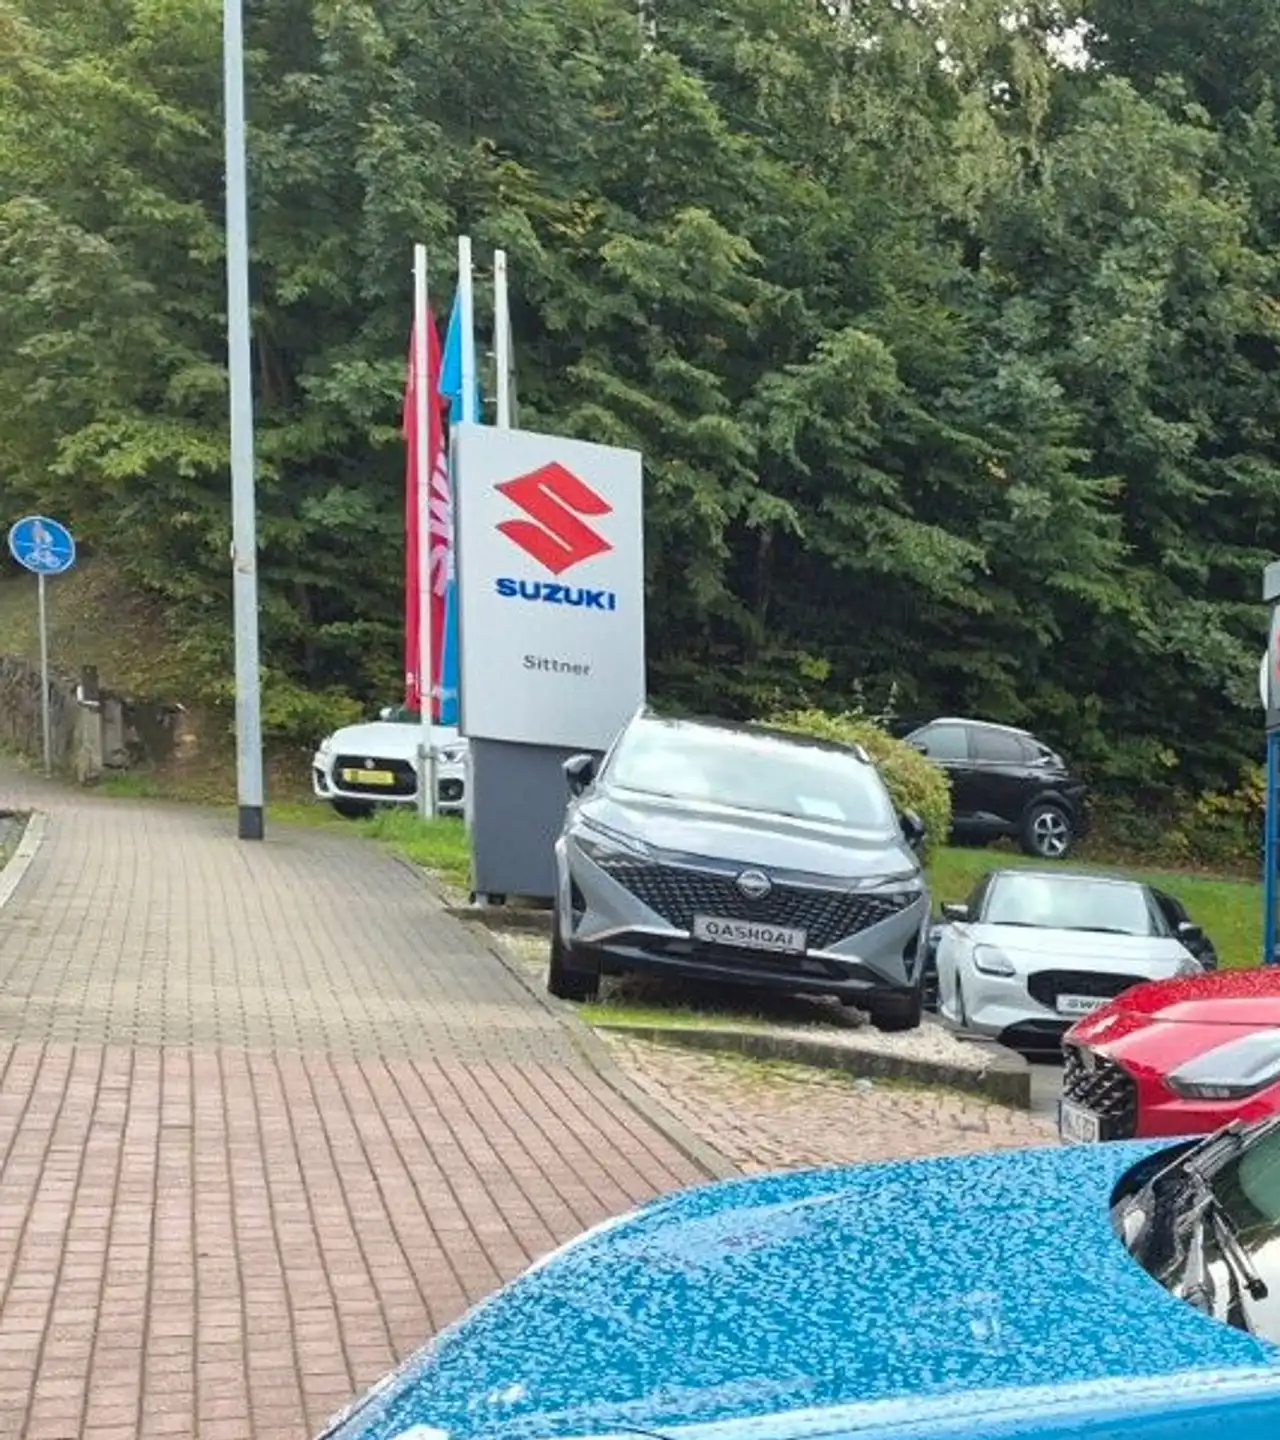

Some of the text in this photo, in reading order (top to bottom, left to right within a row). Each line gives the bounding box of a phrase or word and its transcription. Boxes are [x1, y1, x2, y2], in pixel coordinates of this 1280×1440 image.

[495, 577, 616, 611] SUZUKI
[522, 654, 591, 675] Sittner
[705, 920, 795, 945] QASHQAI
